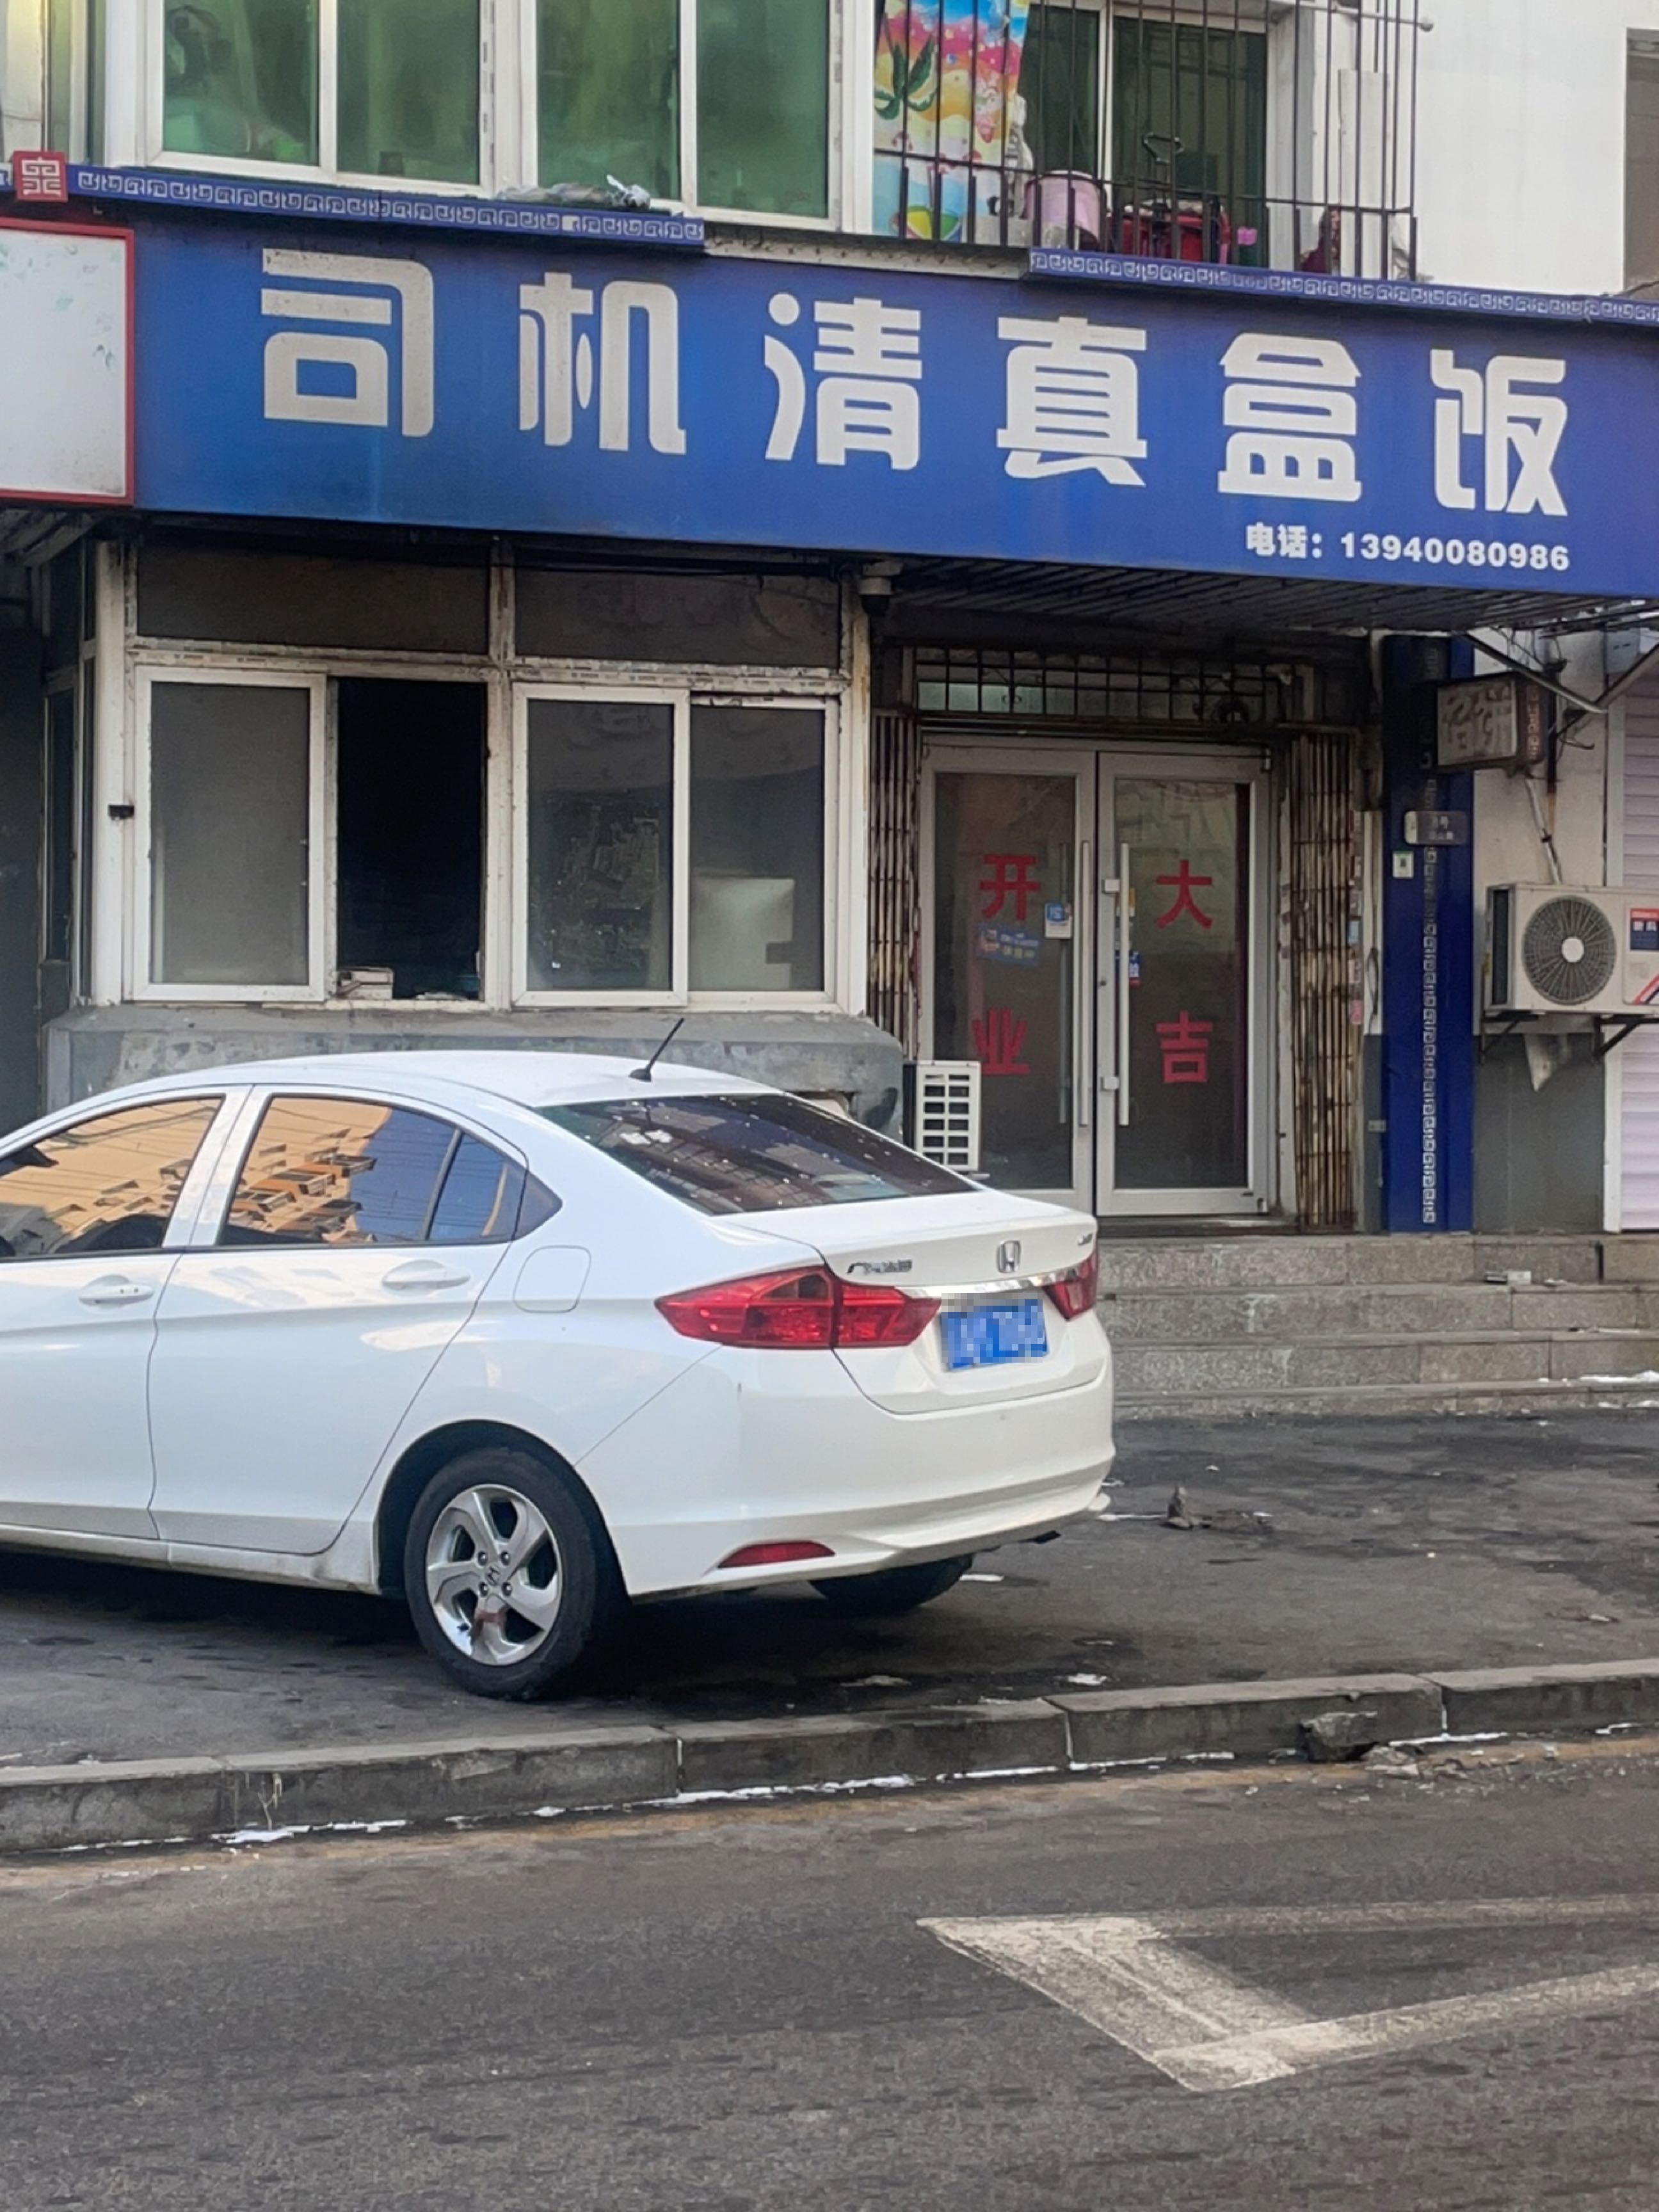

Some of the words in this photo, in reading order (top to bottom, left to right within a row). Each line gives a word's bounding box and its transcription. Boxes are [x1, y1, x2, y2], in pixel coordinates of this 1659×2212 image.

[261, 248, 1569, 517] 司机清真盒饭
